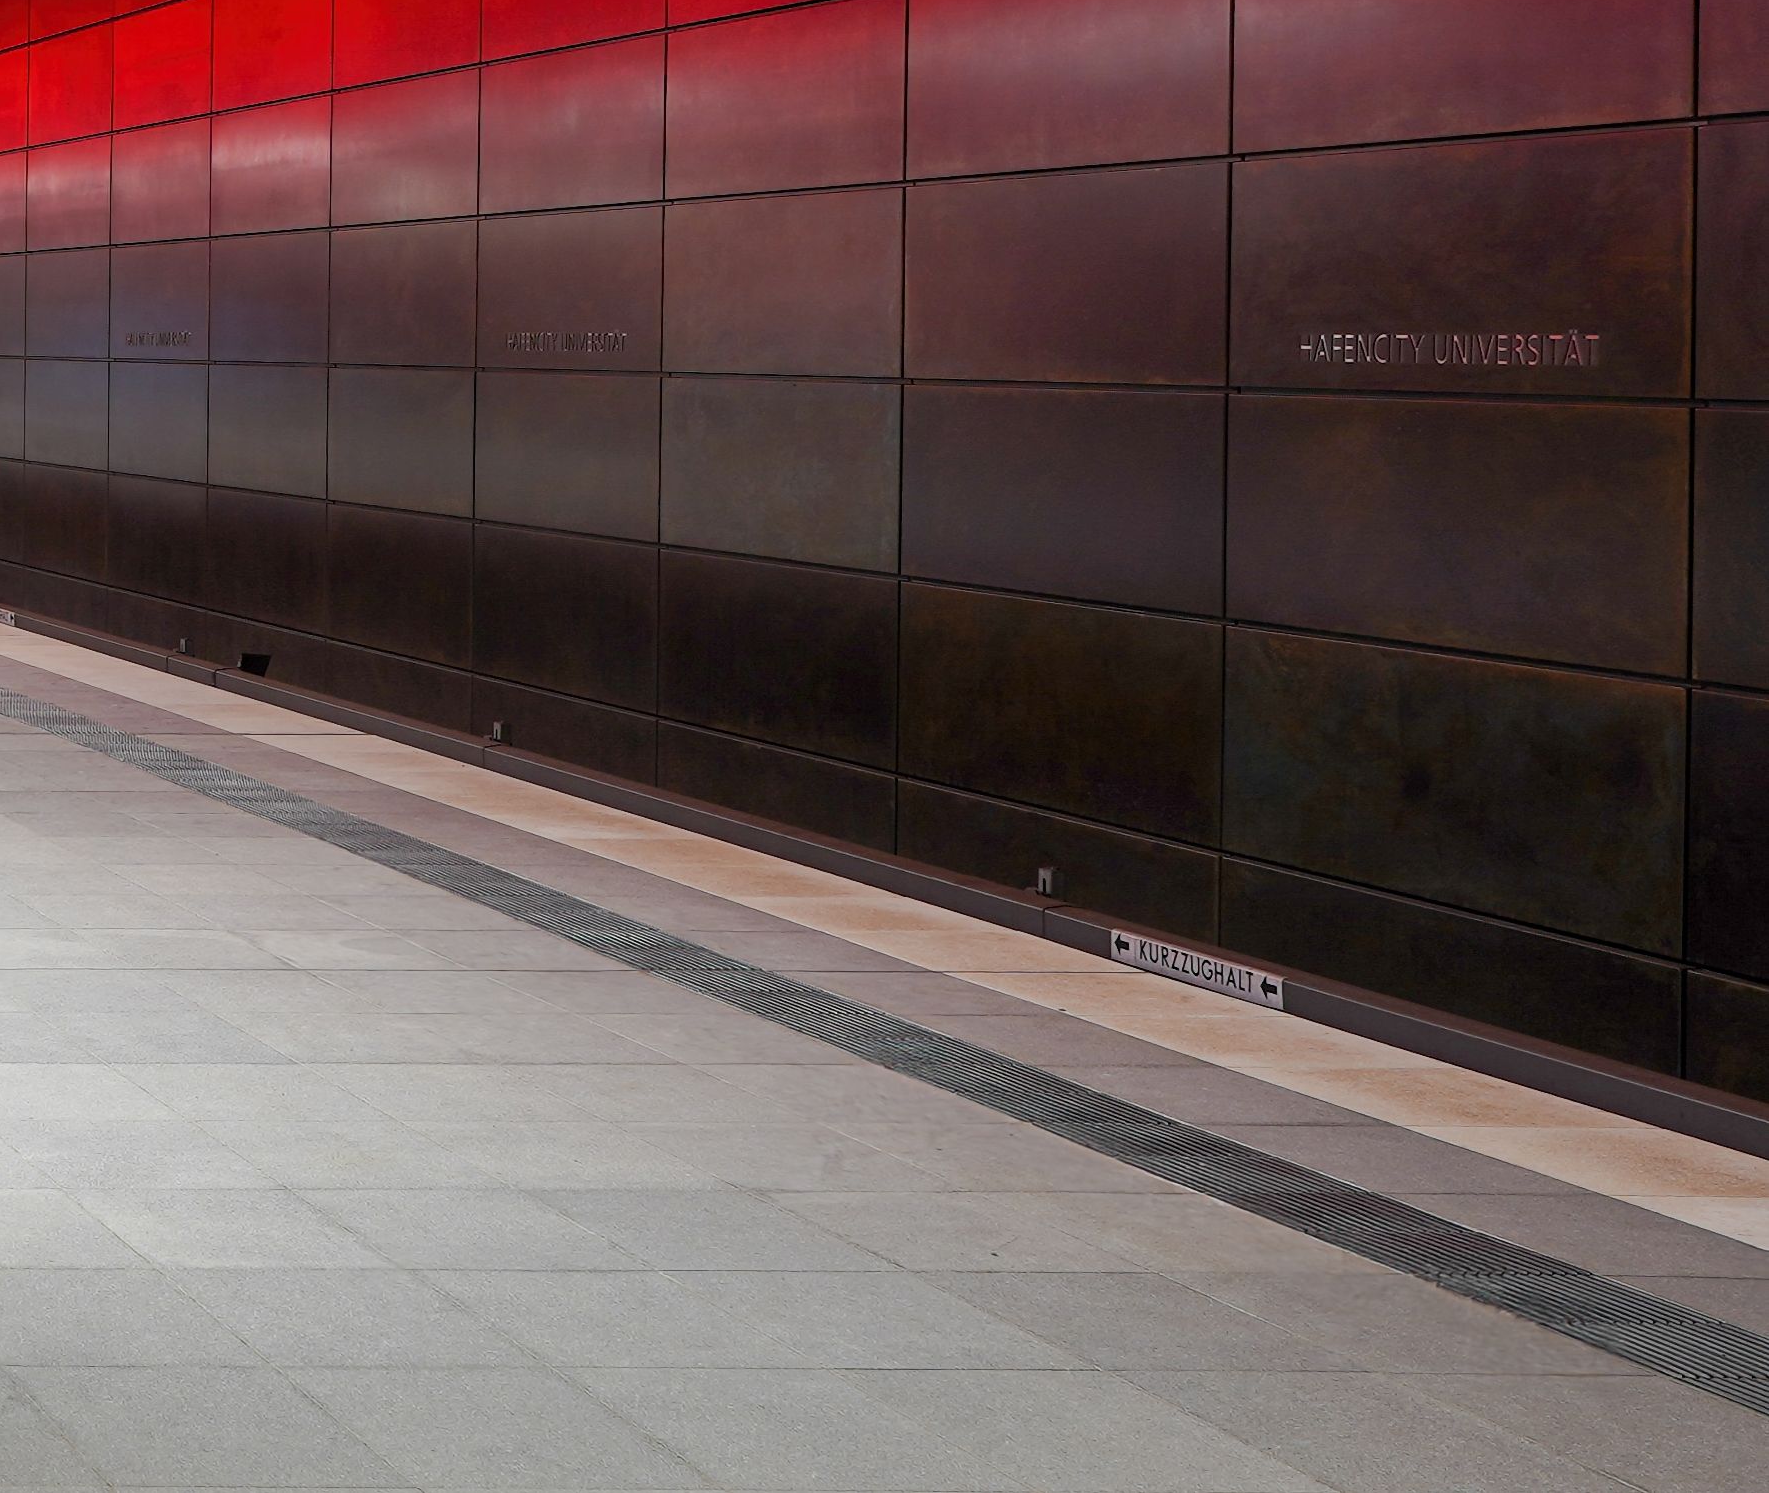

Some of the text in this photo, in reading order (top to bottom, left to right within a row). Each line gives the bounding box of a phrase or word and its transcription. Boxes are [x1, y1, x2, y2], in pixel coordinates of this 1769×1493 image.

[1300, 329, 1600, 367] HAFENCITY UNIVERSITÄT
[1139, 939, 1254, 993] KURZZUGHALT
